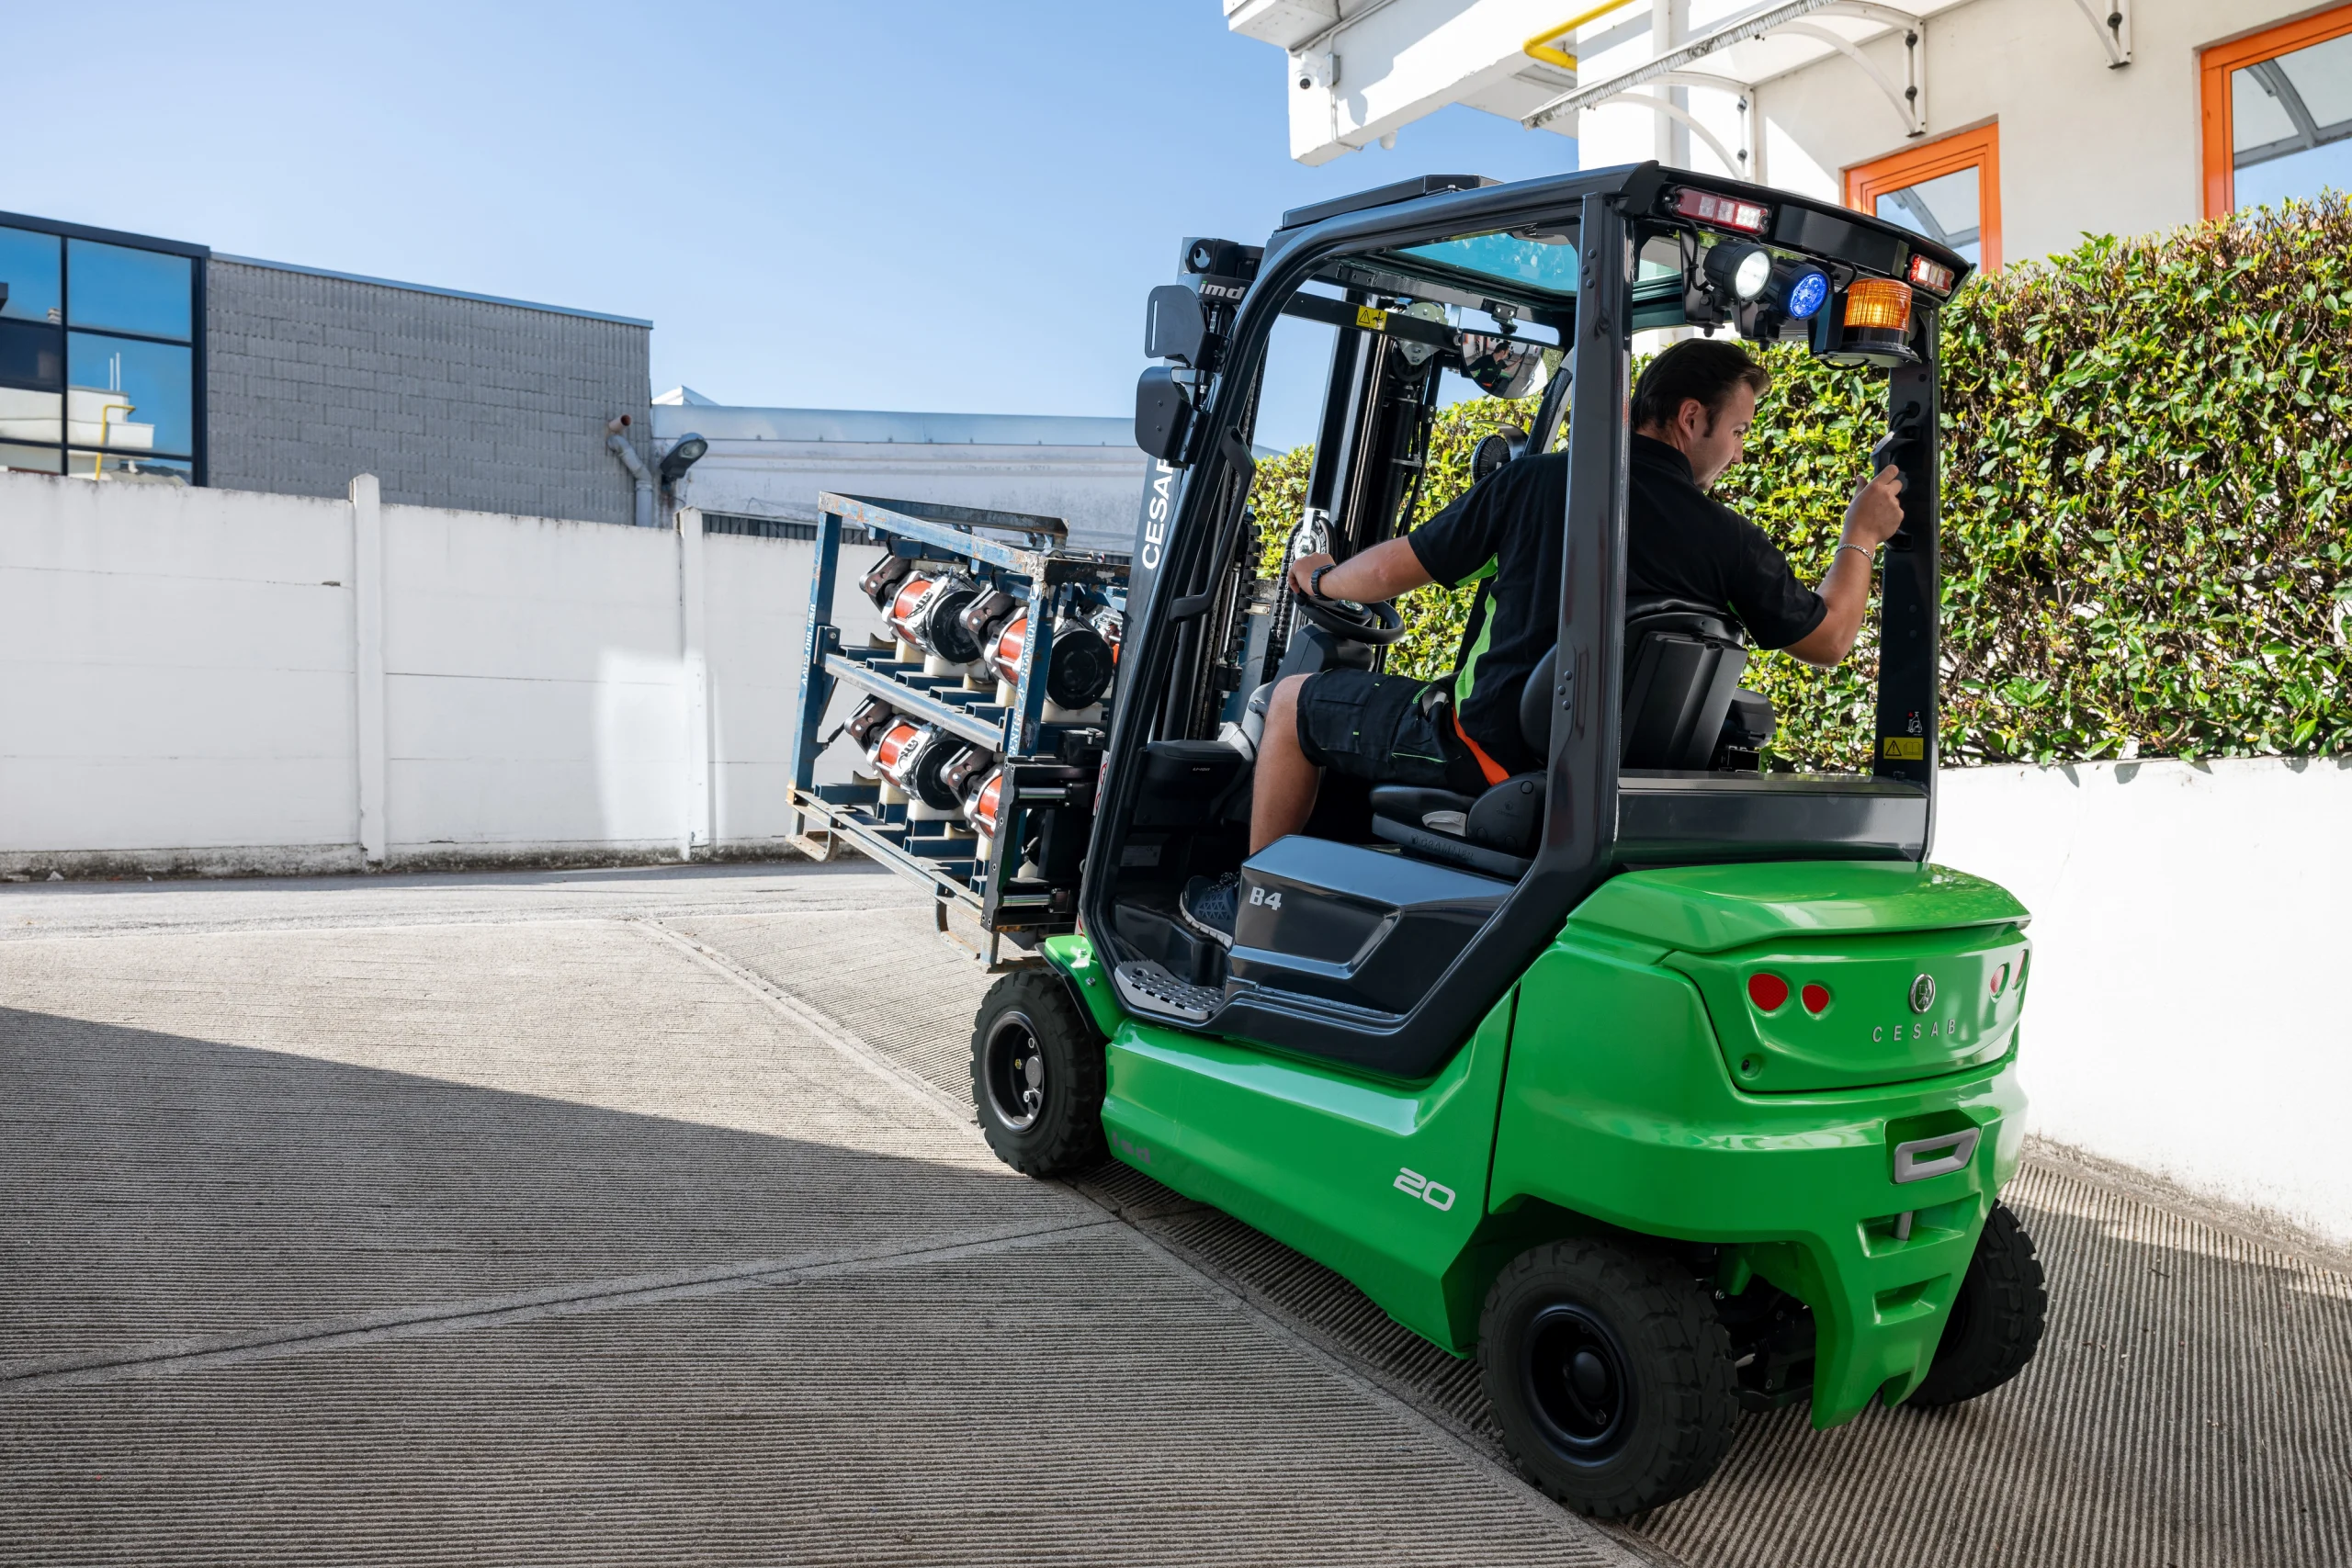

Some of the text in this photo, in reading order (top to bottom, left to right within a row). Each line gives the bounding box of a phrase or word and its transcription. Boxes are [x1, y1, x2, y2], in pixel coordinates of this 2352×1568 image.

[1198, 280, 1246, 300] imd
[1249, 886, 1283, 911] B4
[1871, 1018, 1956, 1043] CESAB
[1392, 1167, 1456, 1212] 20
